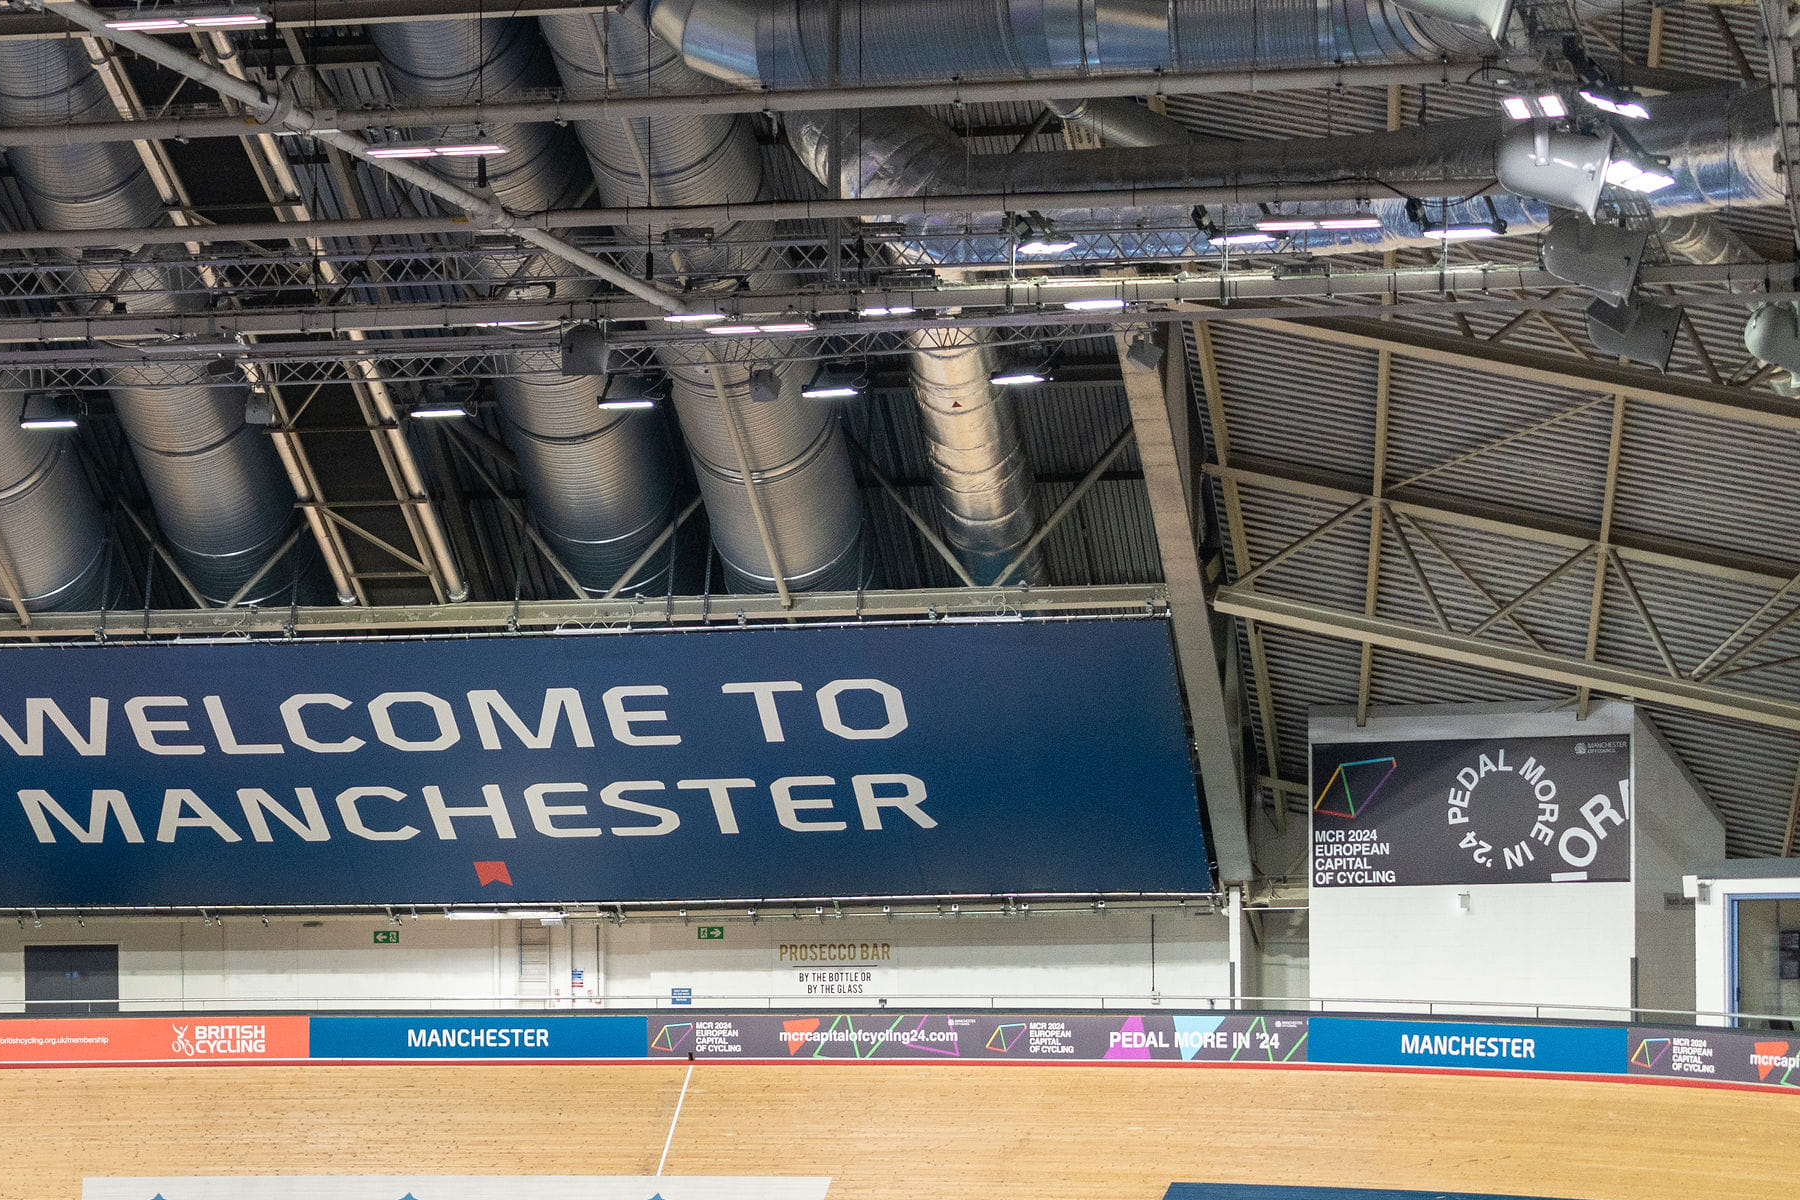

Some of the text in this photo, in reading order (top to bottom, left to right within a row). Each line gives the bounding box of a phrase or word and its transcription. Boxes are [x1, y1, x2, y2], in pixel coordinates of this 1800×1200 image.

[722, 678, 909, 742] TO
[1448, 749, 1514, 825] PEDAL
[17, 773, 938, 843] MANCHESTER
[1518, 756, 1559, 846] MORE
[1315, 829, 1377, 843] MCR 2024
[1315, 843, 1390, 857] EUROPEAN
[1502, 840, 1535, 870] IN
[1315, 858, 1372, 871] CAPITAL
[1315, 870, 1396, 884] OF CYCLING
[779, 942, 891, 961] PROSECCO BAR
[799, 971, 872, 983] BY THE BOTTLE OR
[807, 984, 863, 994] BY THE GLASS
[195, 1025, 265, 1039] BRITISH
[1029, 1022, 1065, 1030] MCR 2024
[0, 1036, 109, 1046] britishcycling.org.uk/membership
[407, 1028, 549, 1048] MANCHESTER
[696, 1030, 738, 1038] EUROPEAN
[696, 1037, 728, 1045] CAPITAL
[779, 1030, 958, 1046] mcrcapitalofcycling24.com
[1029, 1030, 1072, 1038] EUROPEAN
[1109, 1031, 1169, 1048] PEDAL
[1173, 1032, 1229, 1048] MORE
[1232, 1032, 1250, 1048] IN
[195, 1038, 265, 1053] CYCLING
[709, 1044, 741, 1052] CYCLING
[1029, 1038, 1061, 1046] CAPITAL
[1401, 1034, 1535, 1059] MANCHESTER
[1673, 1038, 1707, 1047] MCR 2024
[1029, 1046, 1074, 1054] OF CYCLING
[1673, 1046, 1713, 1056] EUROPEAN
[1672, 1054, 1703, 1065] CAPITAL
